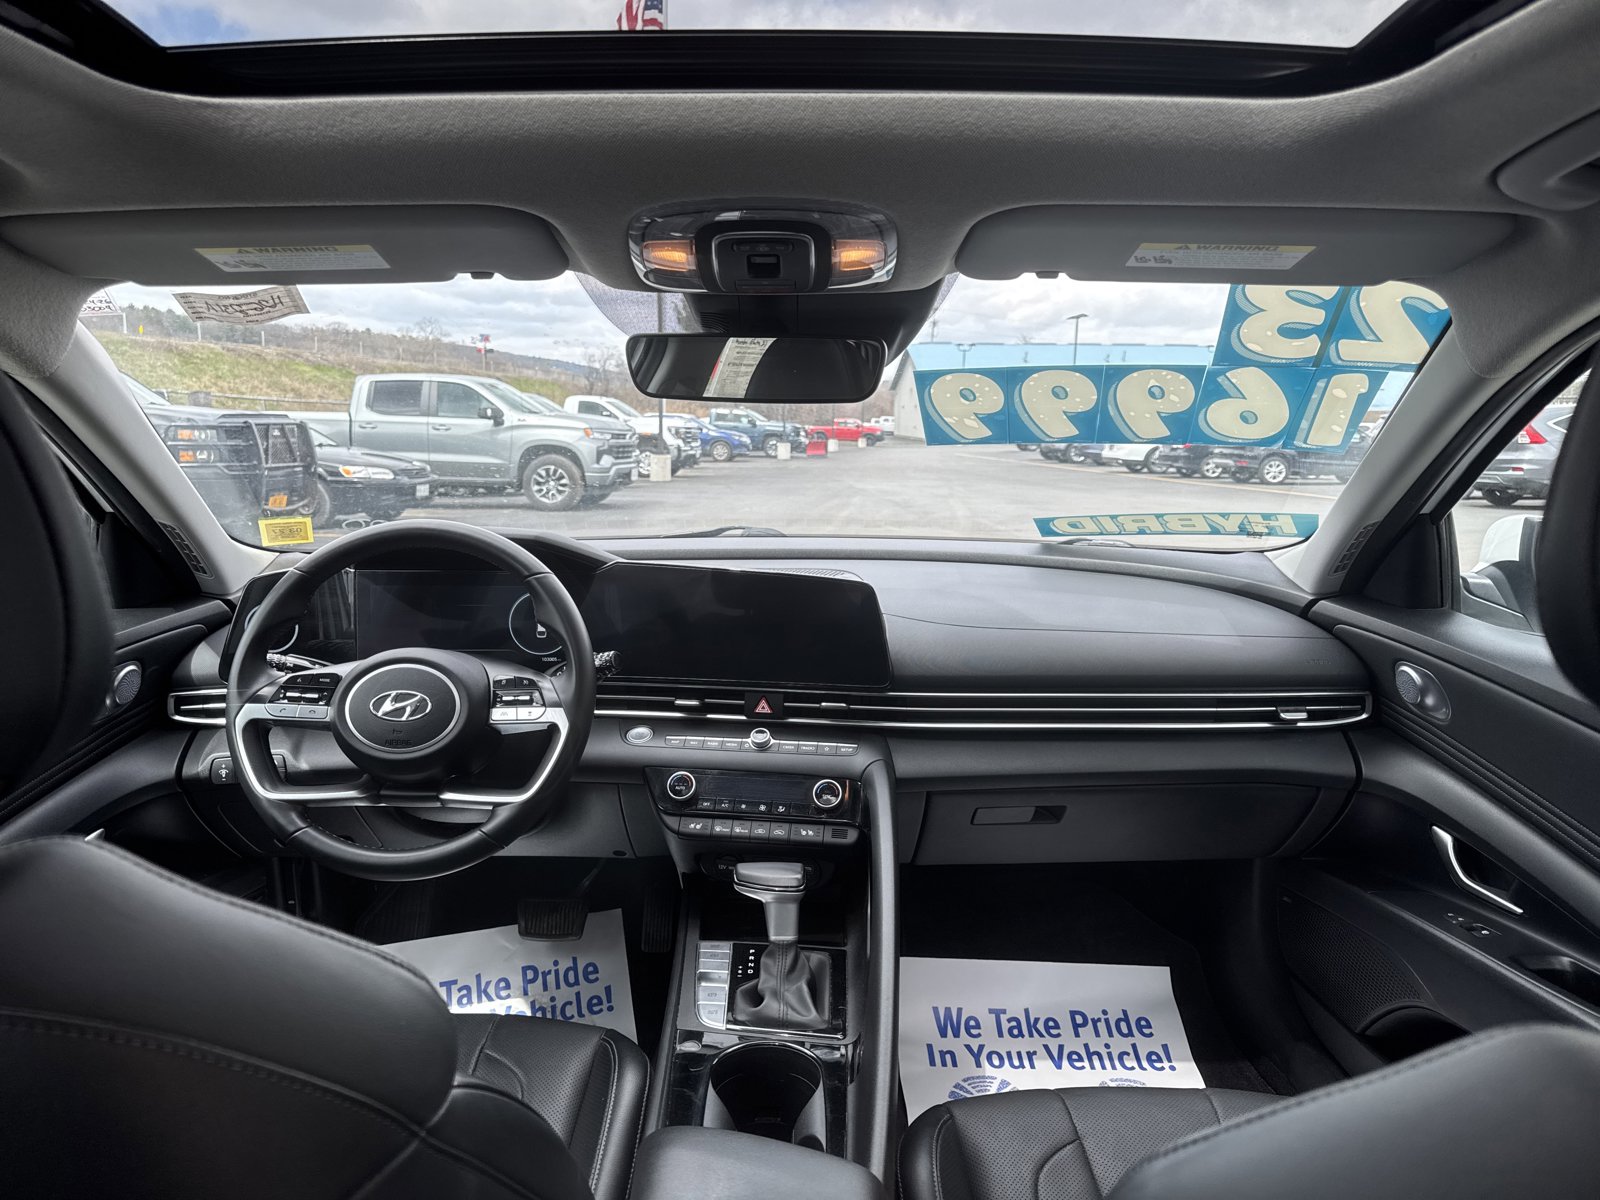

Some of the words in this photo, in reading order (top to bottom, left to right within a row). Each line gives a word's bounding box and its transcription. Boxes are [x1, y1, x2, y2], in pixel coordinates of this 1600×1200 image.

[252, 245, 338, 254] WARNING
[1196, 244, 1280, 252] WARNING
[439, 972, 511, 1009] Take
[521, 956, 600, 997] Pride
[931, 1005, 982, 1039] We
[988, 1007, 1061, 1039] Take
[1070, 1007, 1155, 1039] Pride
[926, 1043, 958, 1068] In
[963, 1043, 1038, 1071] Your
[1042, 1042, 1177, 1072] Vehicle!
